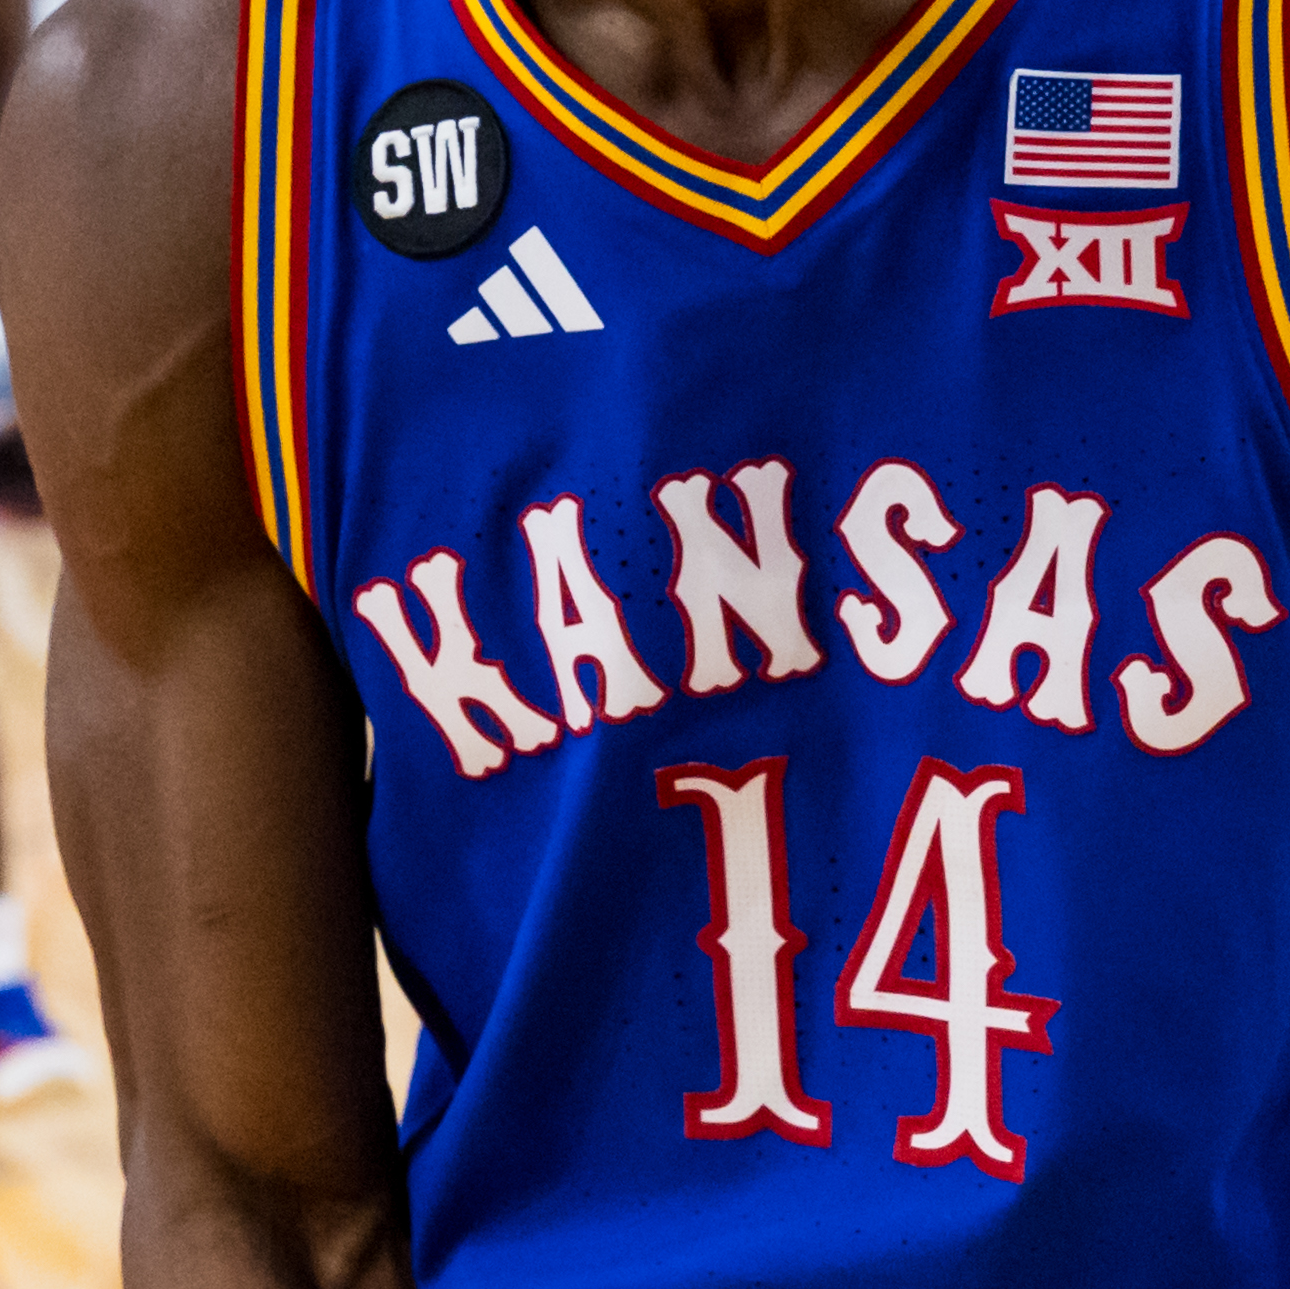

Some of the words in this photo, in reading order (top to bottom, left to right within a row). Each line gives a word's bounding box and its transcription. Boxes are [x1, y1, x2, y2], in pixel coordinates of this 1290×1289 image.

[371, 116, 480, 220] SW
[1003, 212, 1179, 308] XII
[350, 453, 1288, 782] KANSAS
[654, 755, 1062, 1184] 14
